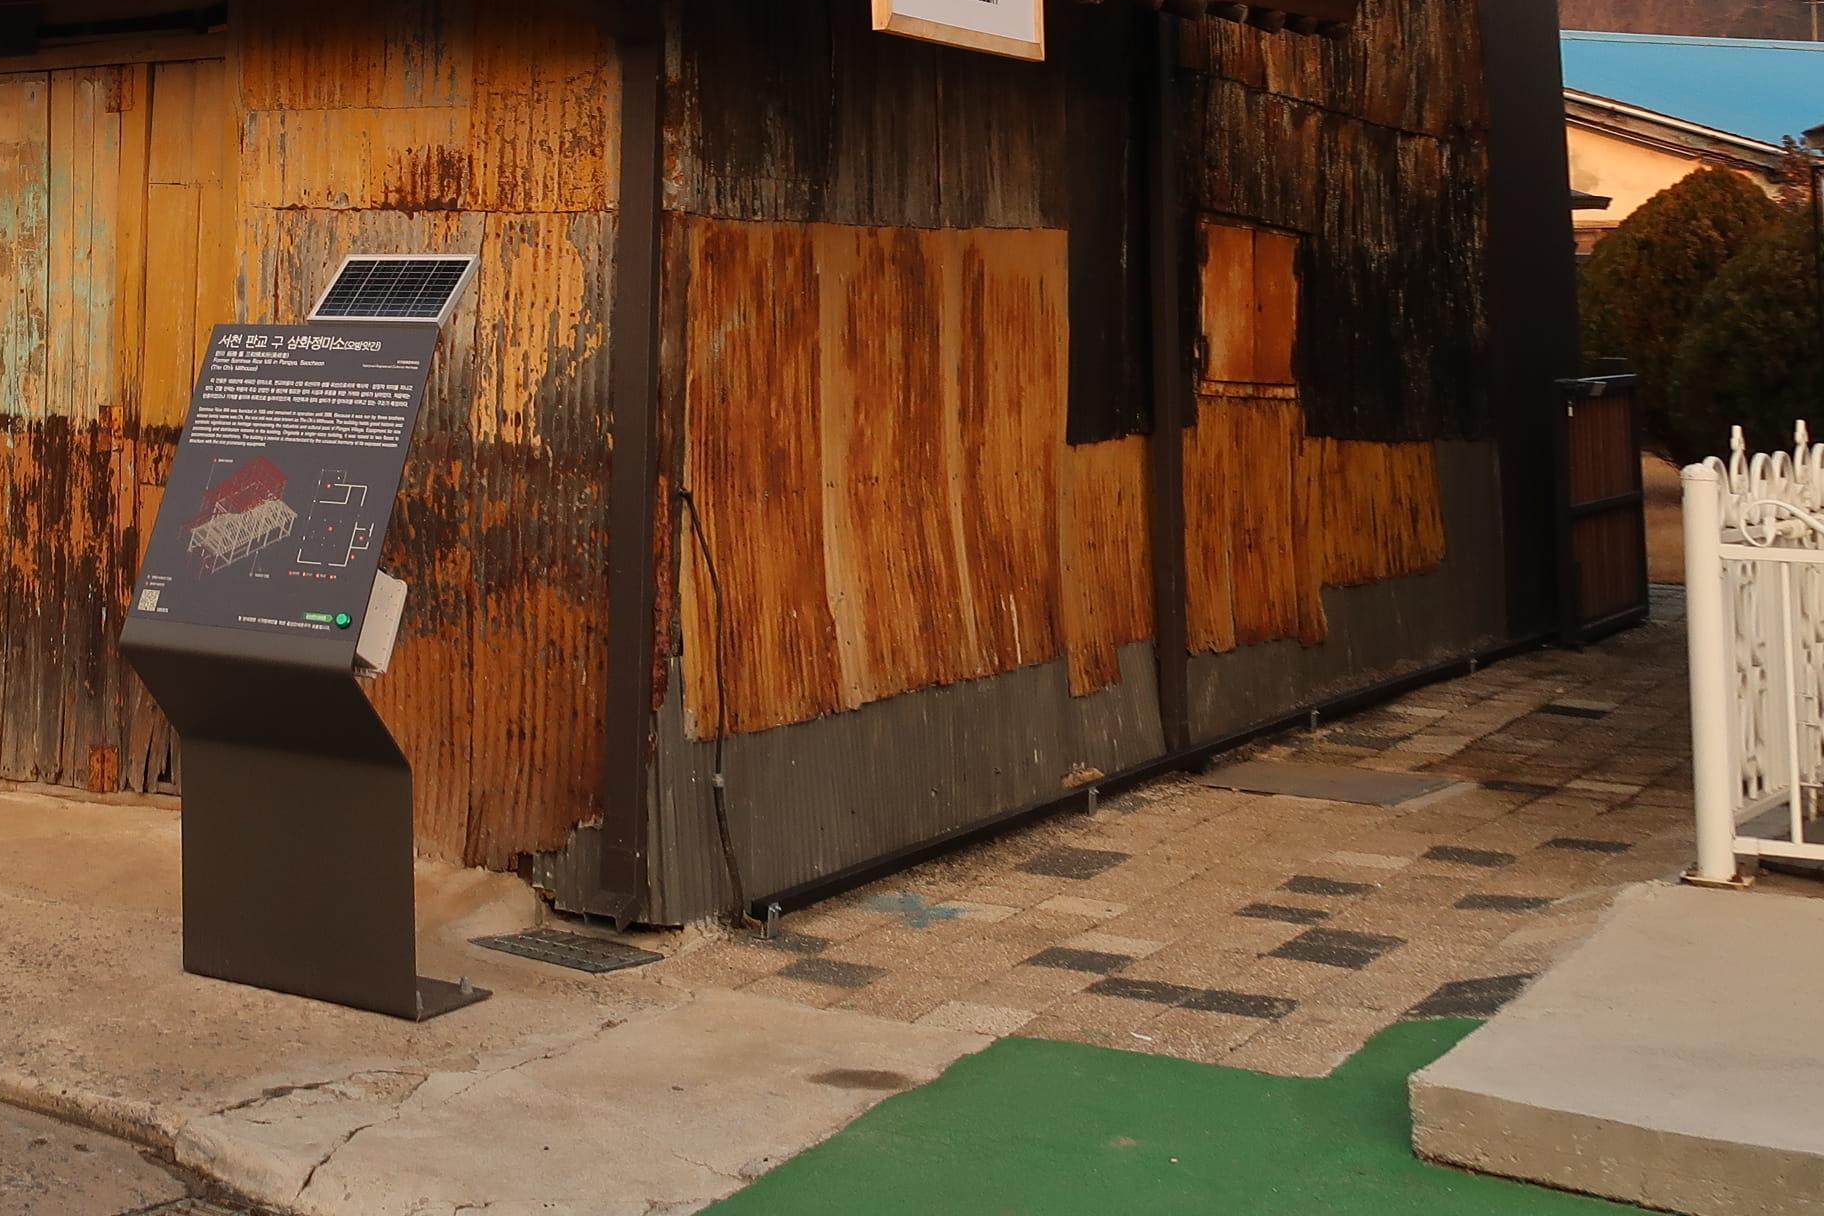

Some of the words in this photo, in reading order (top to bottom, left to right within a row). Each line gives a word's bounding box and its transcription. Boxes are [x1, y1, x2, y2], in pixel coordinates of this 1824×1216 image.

[218, 333, 243, 348] 서천
[245, 334, 268, 349] 판교
[271, 335, 284, 349] 구
